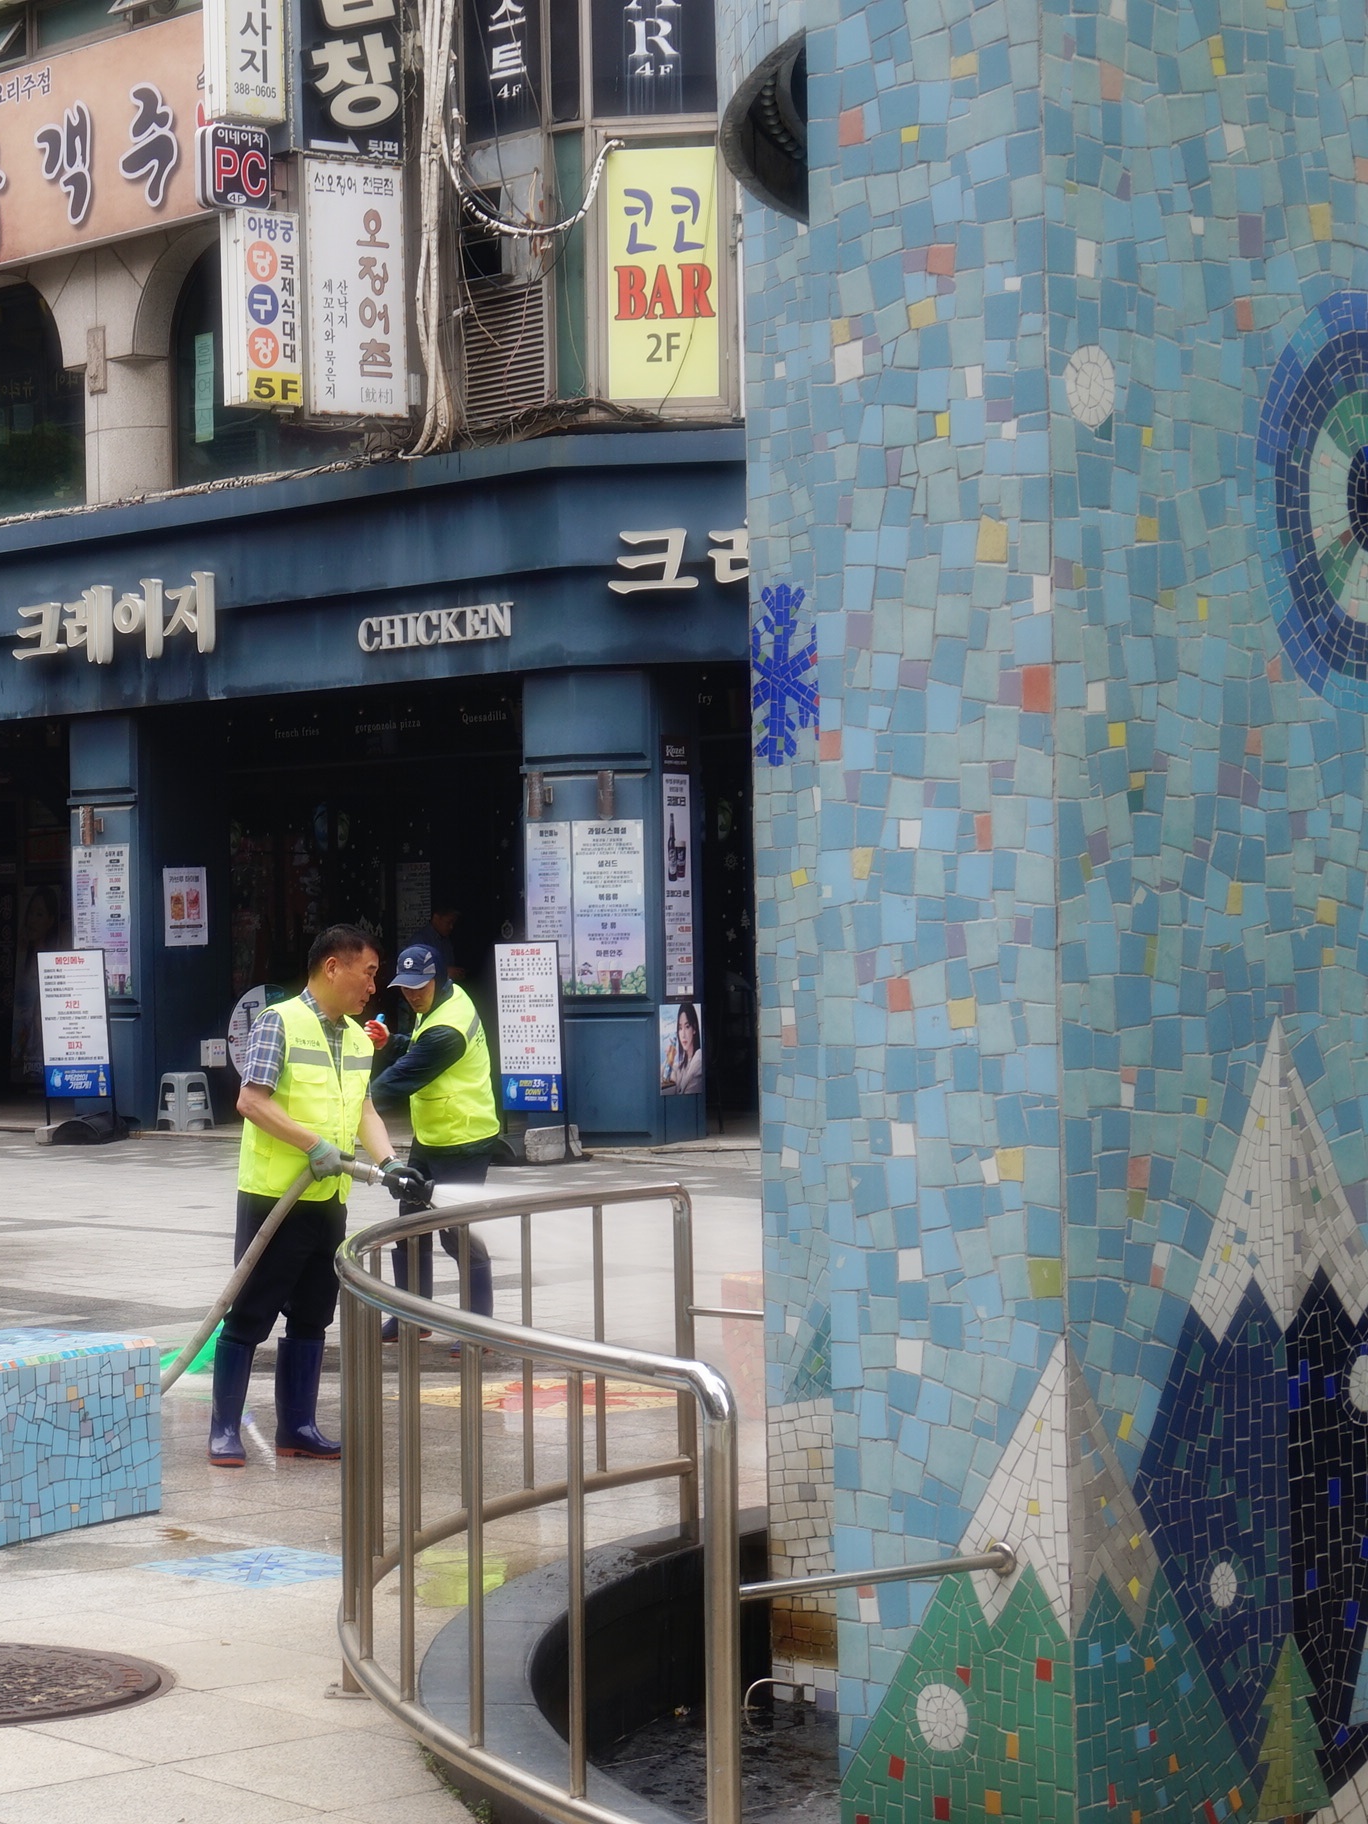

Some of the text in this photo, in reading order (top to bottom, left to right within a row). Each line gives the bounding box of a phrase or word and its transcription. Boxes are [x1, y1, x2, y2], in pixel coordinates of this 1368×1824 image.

[239, 0, 272, 84] 사지
[311, 0, 401, 129] 창
[234, 82, 277, 99] 388-0605
[217, 128, 265, 148] 이네이처
[215, 146, 267, 198] PC
[362, 174, 394, 198] 전문점
[247, 217, 295, 243] 아방궁
[622, 186, 706, 256] 코코
[253, 249, 275, 361] 당구장
[337, 279, 349, 329] 산낙지
[356, 208, 393, 380] 오징어촌
[614, 262, 716, 322] BAR
[280, 254, 297, 363] 국제식대대
[645, 331, 682, 364] 2F
[253, 376, 299, 400] 5F
[324, 350, 337, 399] 묵은지
[12, 570, 216, 665] 크레이지
[358, 600, 515, 653] CHICKEN
[697, 692, 713, 706] fry
[354, 718, 421, 734] gorgonzola pizza
[461, 710, 507, 725] Quesadilla
[274, 725, 320, 740] french fries
[665, 744, 686, 758] Kozel
[55, 955, 85, 965] 메인메뉴
[595, 949, 624, 958] 마른안주
[65, 1000, 80, 1009] 치킨
